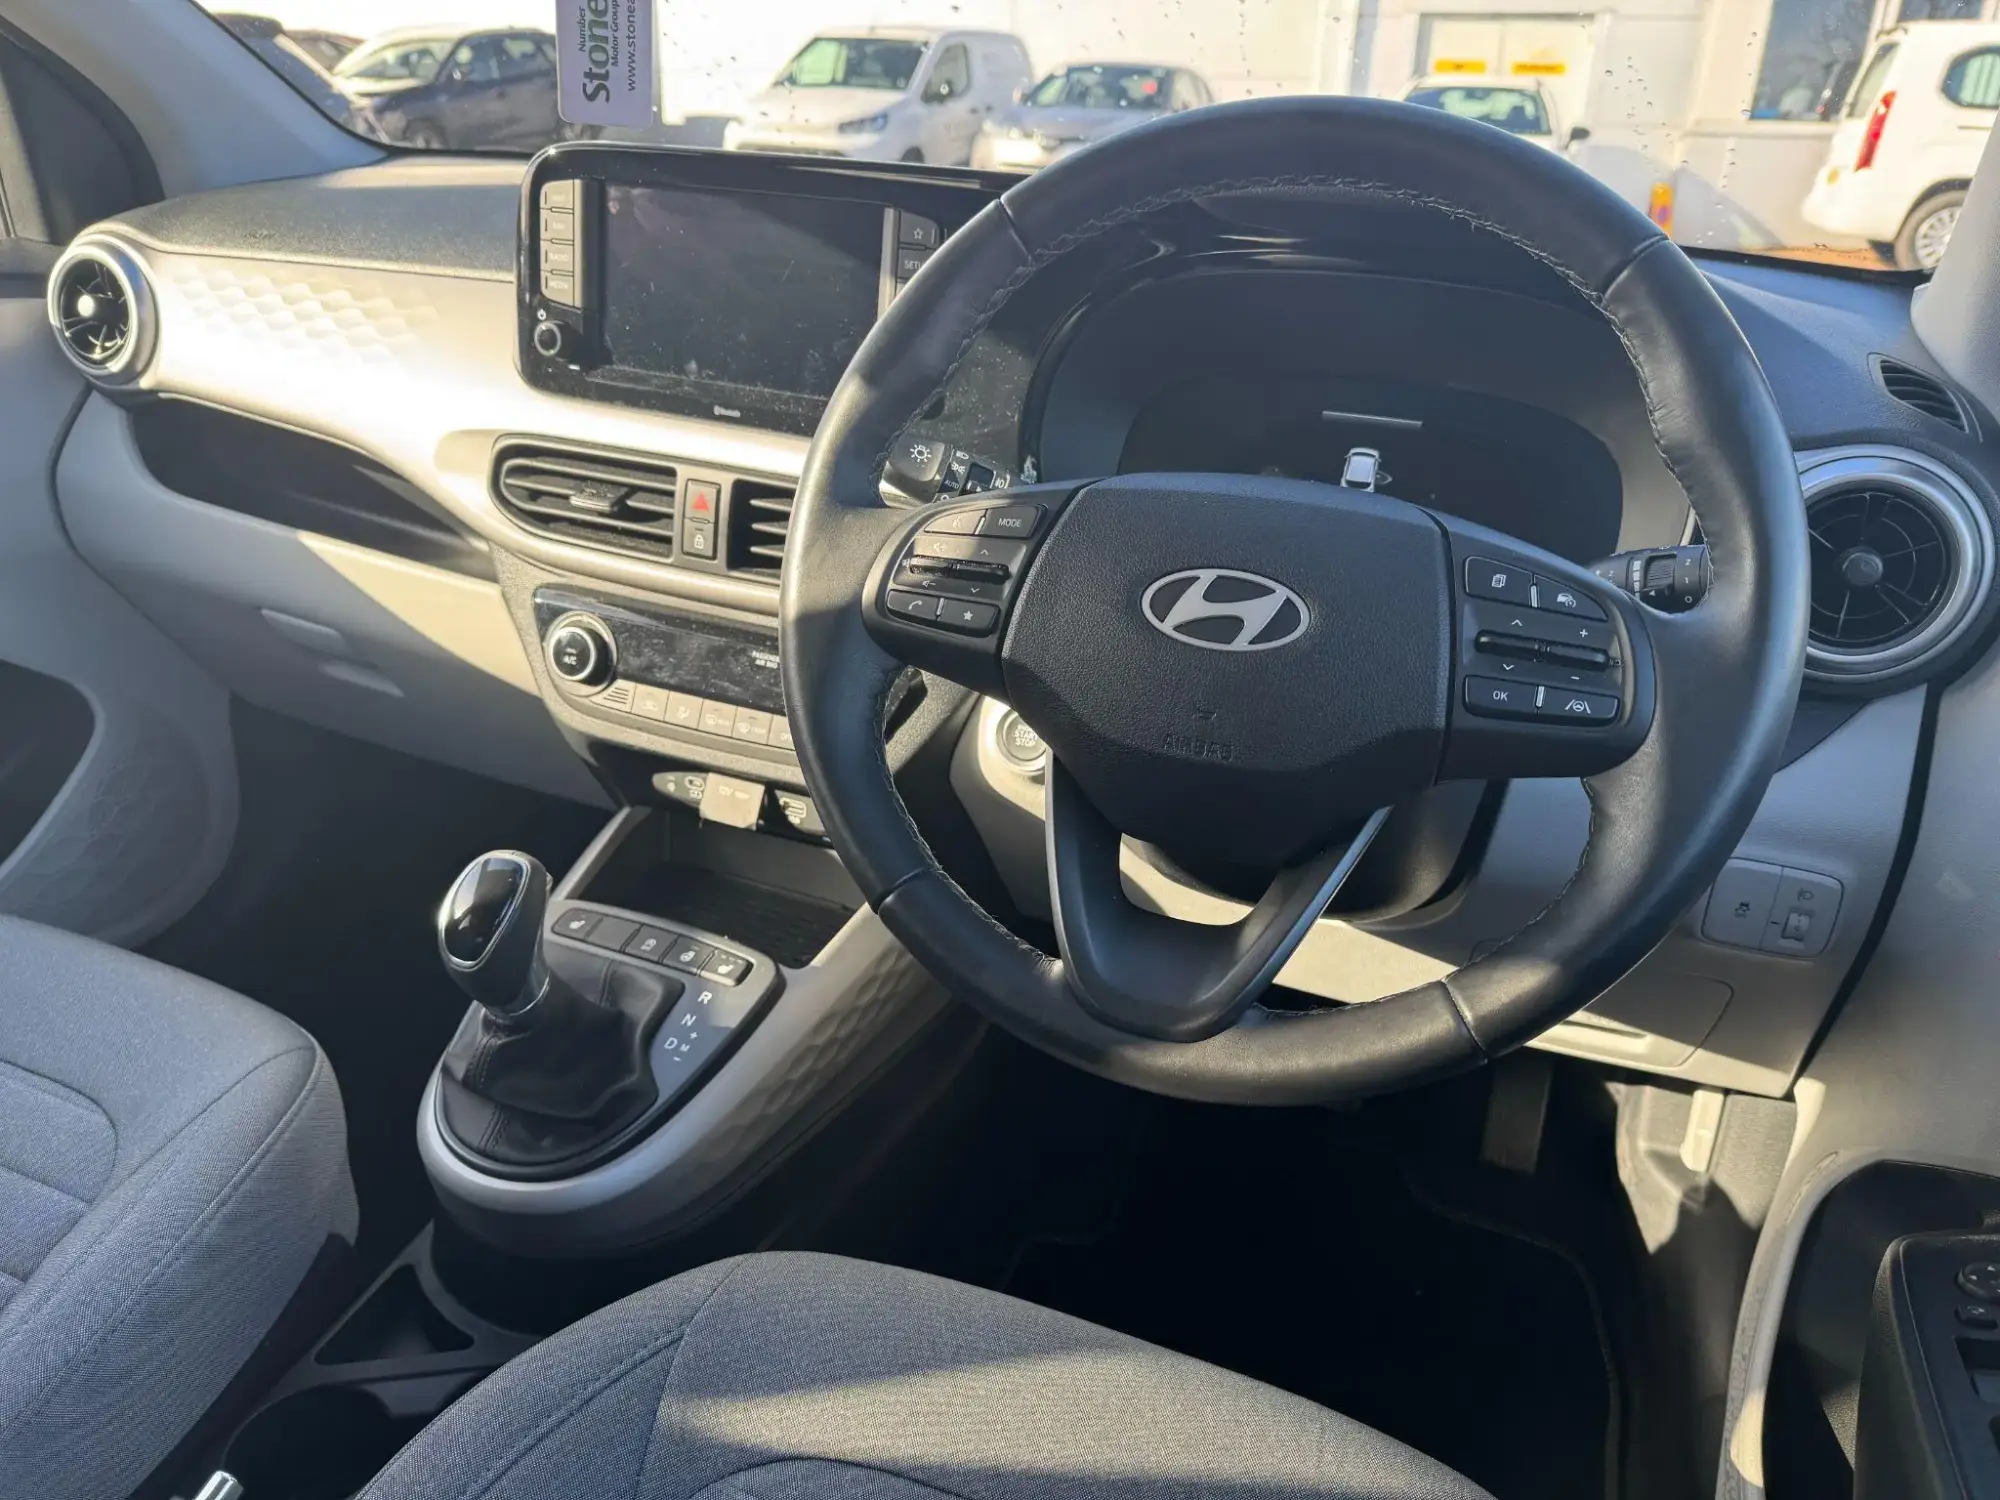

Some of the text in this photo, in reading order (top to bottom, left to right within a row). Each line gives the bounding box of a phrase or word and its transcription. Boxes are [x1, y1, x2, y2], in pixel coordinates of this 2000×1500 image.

[576, 6, 586, 52] Number
[610, 0, 620, 67] Motor Group
[944, 479, 960, 489] AUTO
[998, 517, 1023, 528] MODE
[1492, 690, 1508, 702] OK
[697, 990, 713, 1005] R
[680, 1013, 697, 1027] N
[664, 1037, 678, 1050] D
